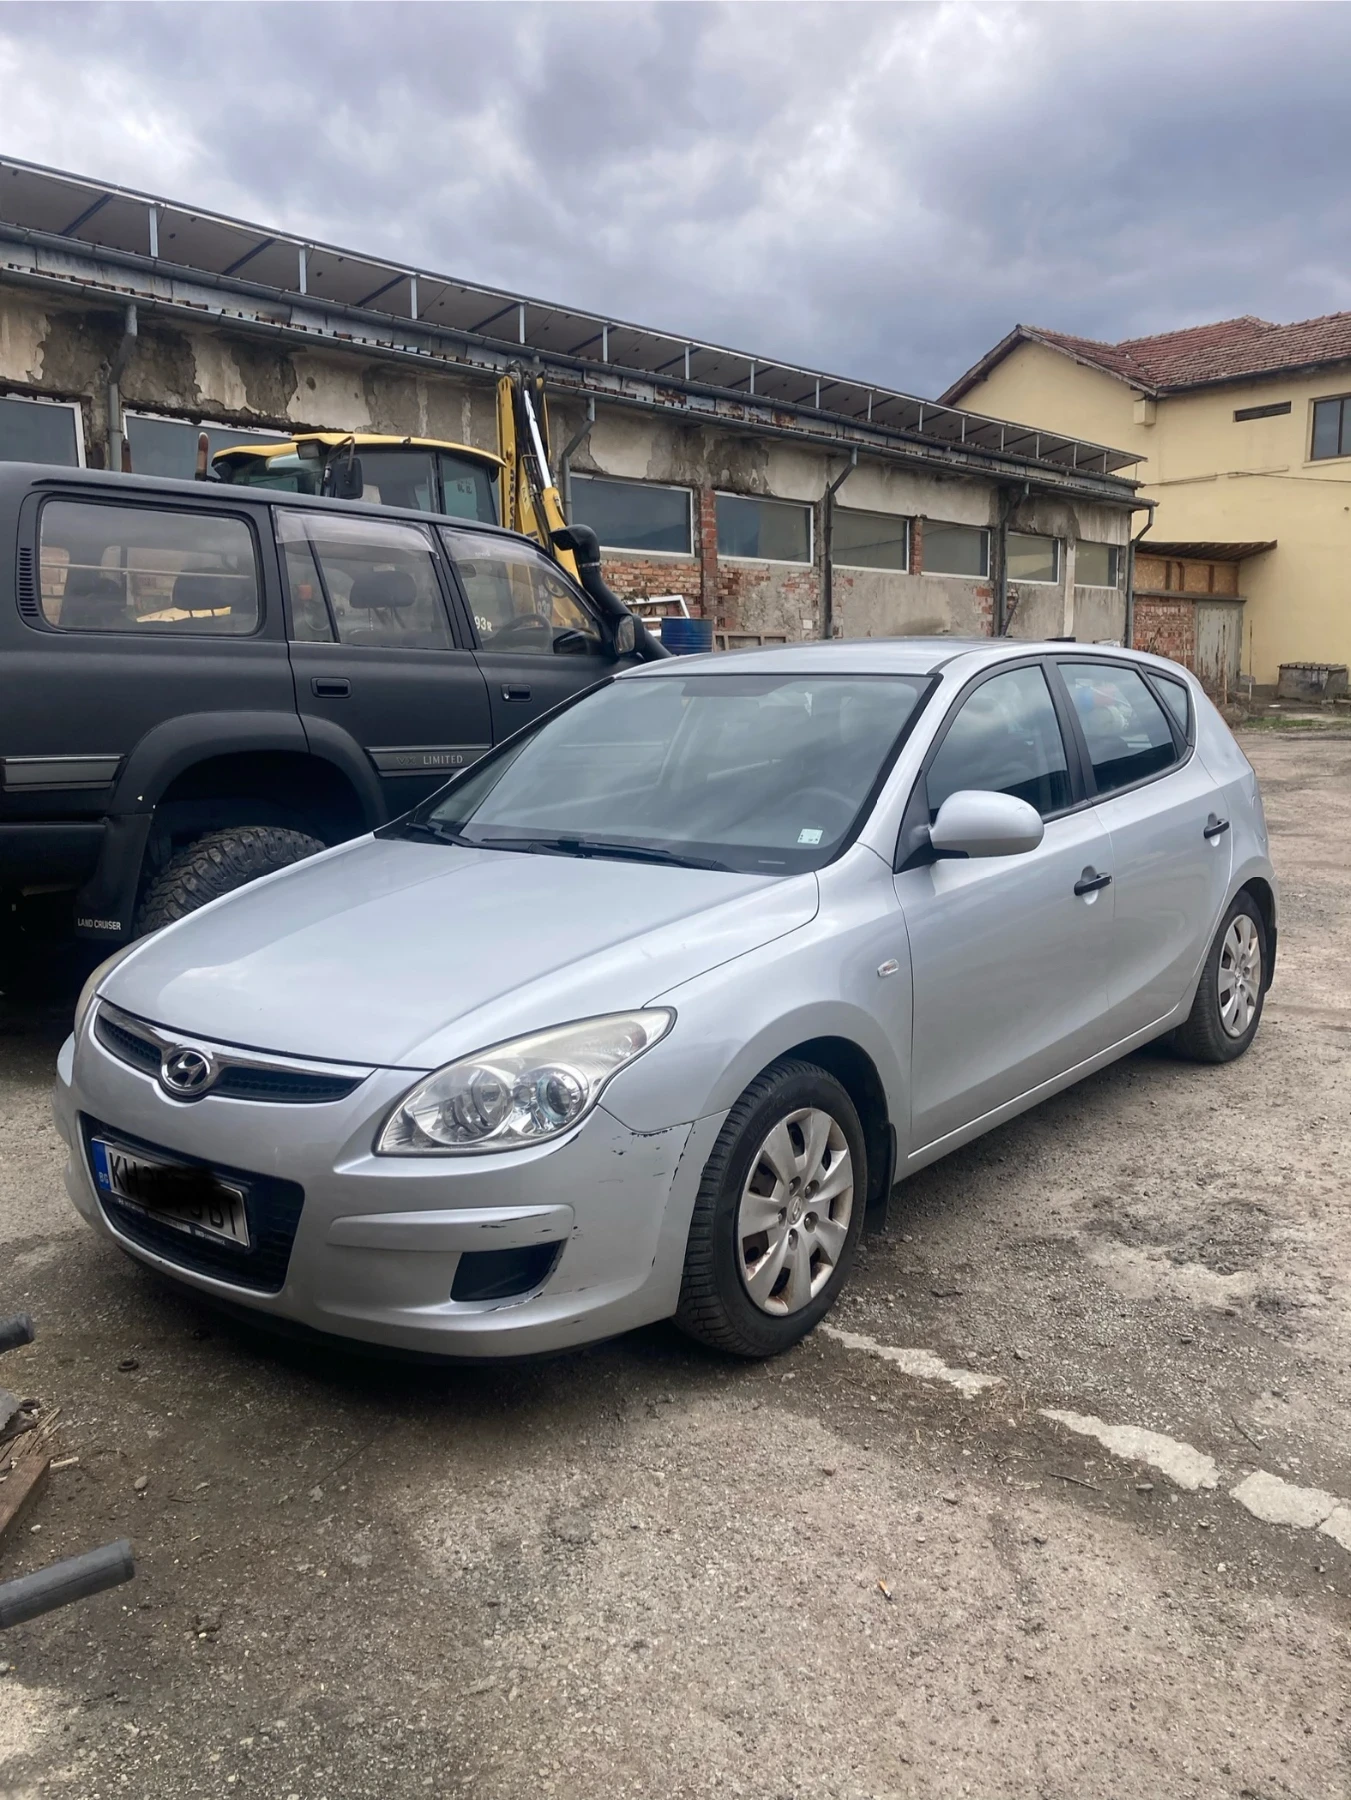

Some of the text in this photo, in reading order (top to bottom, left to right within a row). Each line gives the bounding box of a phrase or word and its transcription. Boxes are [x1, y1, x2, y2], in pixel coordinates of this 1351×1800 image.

[508, 468, 516, 531] MATSU
[423, 755, 463, 765] LIMITED
[77, 918, 122, 931] LAND CRUISER
[98, 1171, 109, 1184] BG
